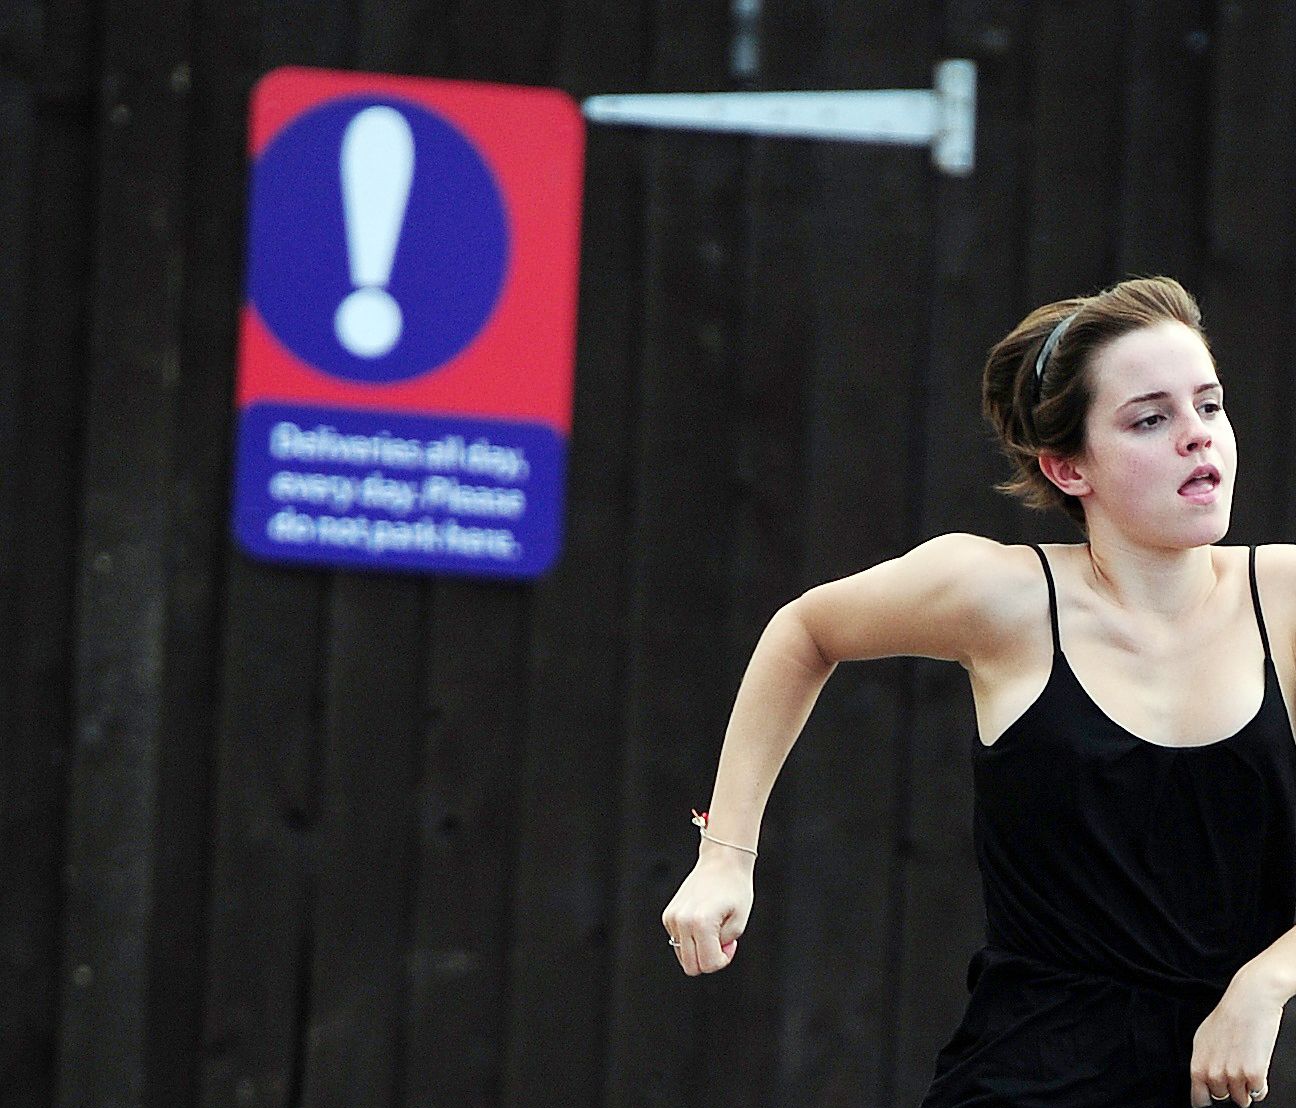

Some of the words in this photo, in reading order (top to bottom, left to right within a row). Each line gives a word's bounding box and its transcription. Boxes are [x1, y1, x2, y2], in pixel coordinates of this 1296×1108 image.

[269, 421, 422, 466] Deliveries
[423, 434, 464, 470] all
[269, 470, 354, 512] every
[421, 475, 527, 519] Please
[266, 508, 315, 544] do
[316, 514, 368, 547] not
[369, 515, 442, 554] park
